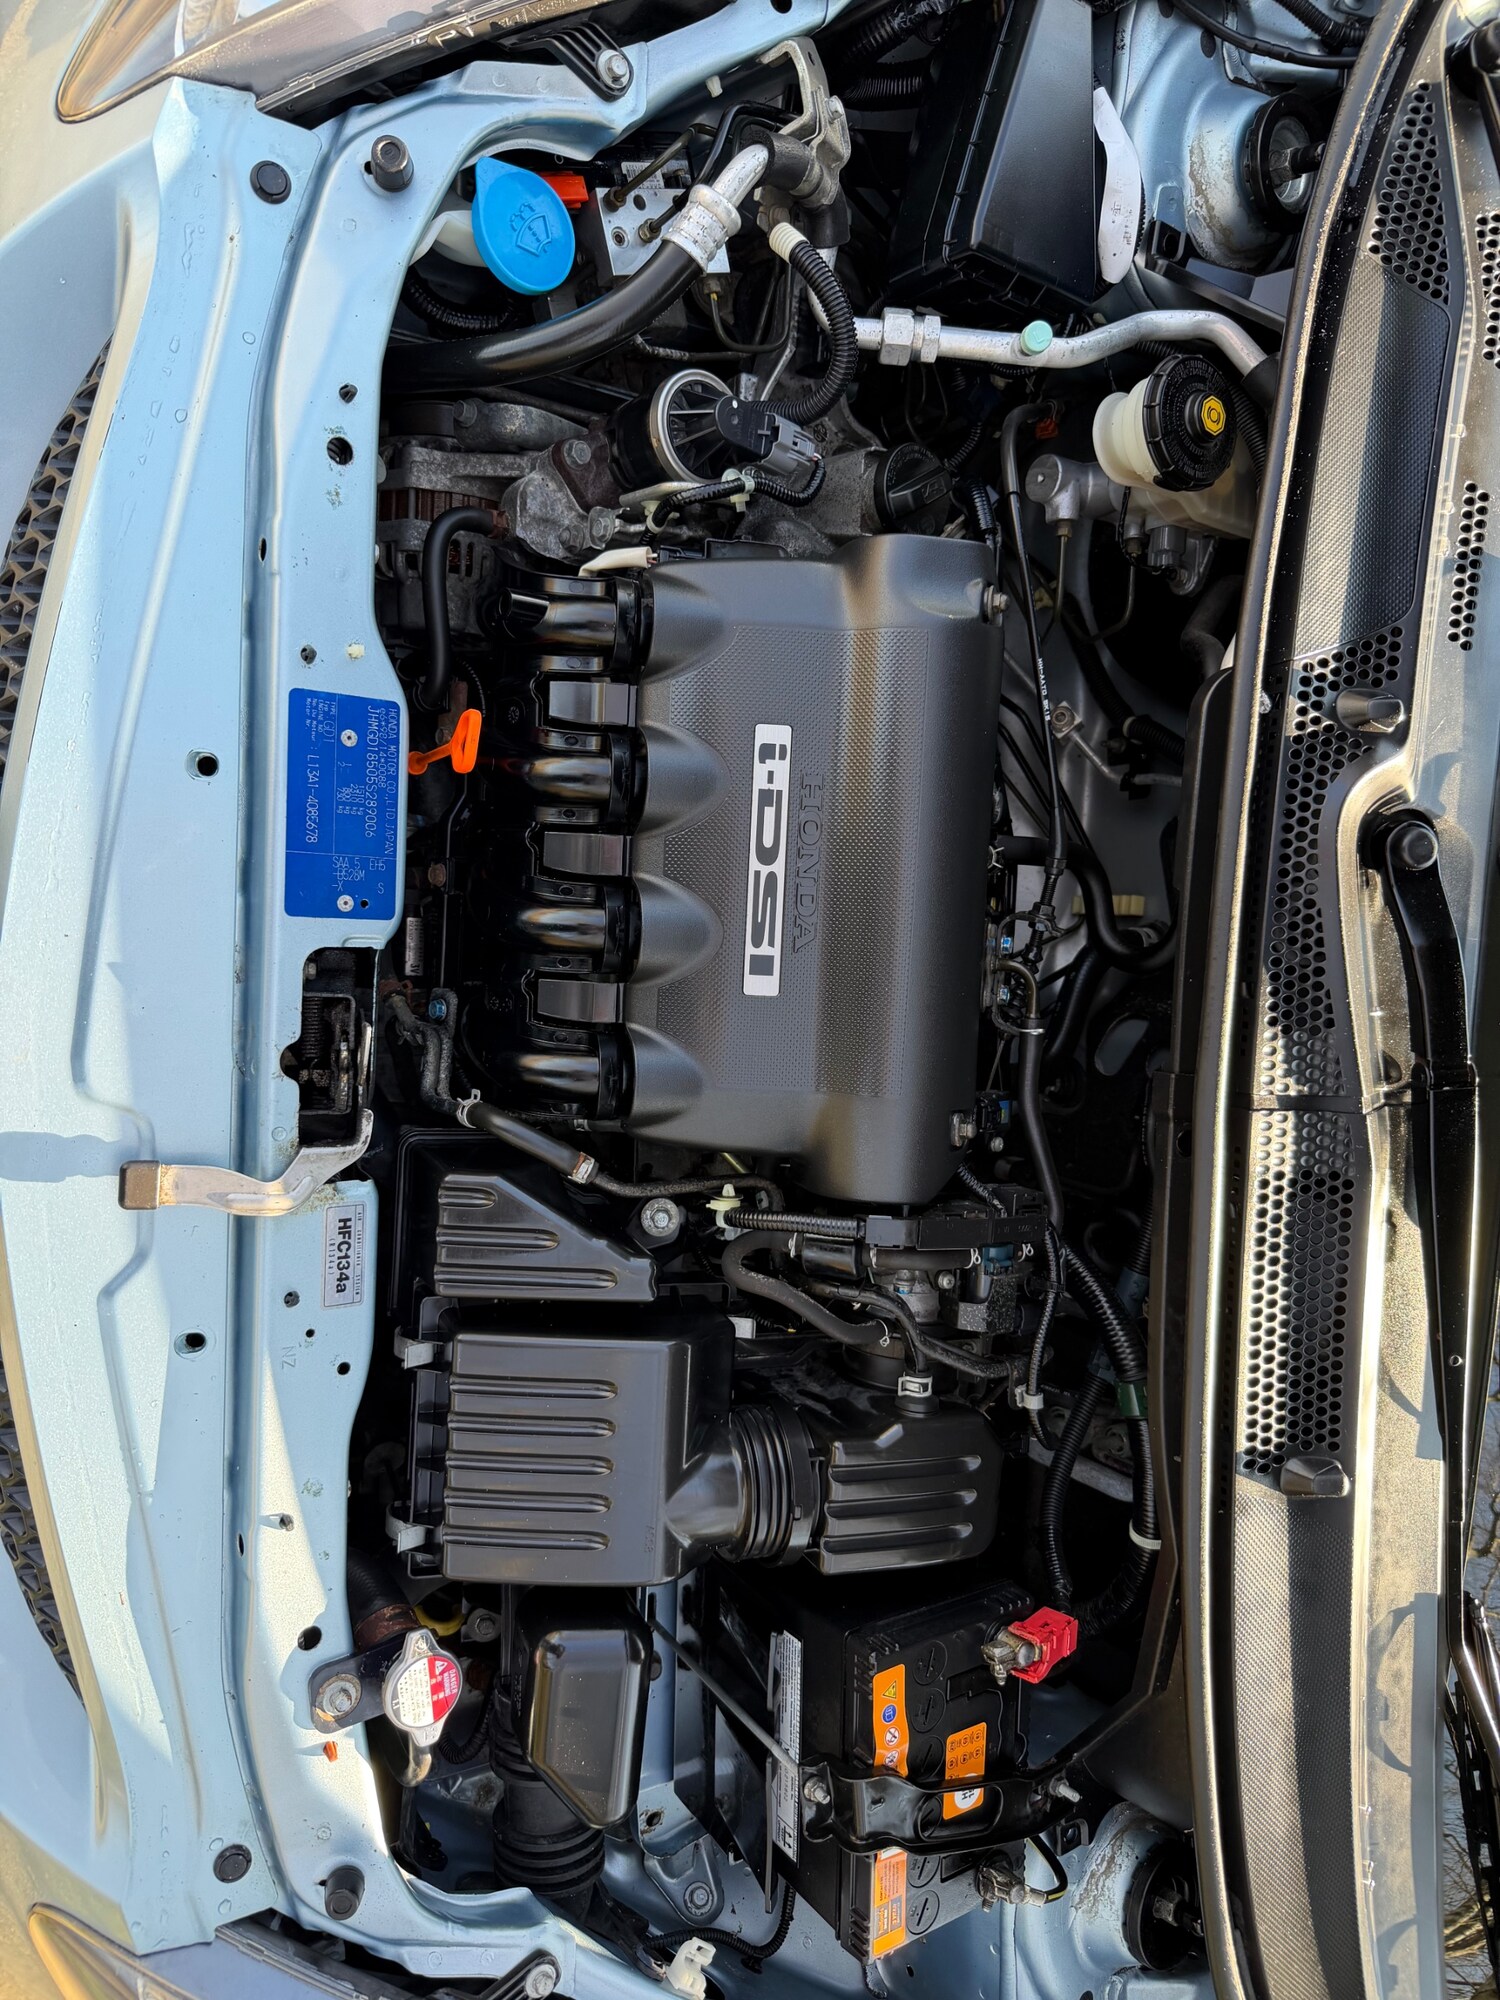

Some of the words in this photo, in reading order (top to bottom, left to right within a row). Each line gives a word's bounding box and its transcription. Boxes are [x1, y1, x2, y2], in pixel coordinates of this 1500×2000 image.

[323, 720, 335, 743] GD1
[387, 708, 398, 739] HONDA
[365, 705, 380, 838] JHMGD18505S289006
[387, 745, 397, 775] MOTOR
[306, 754, 319, 843] L13A1-4085678
[748, 742, 788, 976] i-DSI
[792, 771, 825, 953] HONDA
[327, 1238, 336, 1276] (R134a)
[335, 1217, 353, 1294] HFC134a
[443, 1671, 452, 1697] WARNING
[449, 1668, 459, 1695] DANGER
